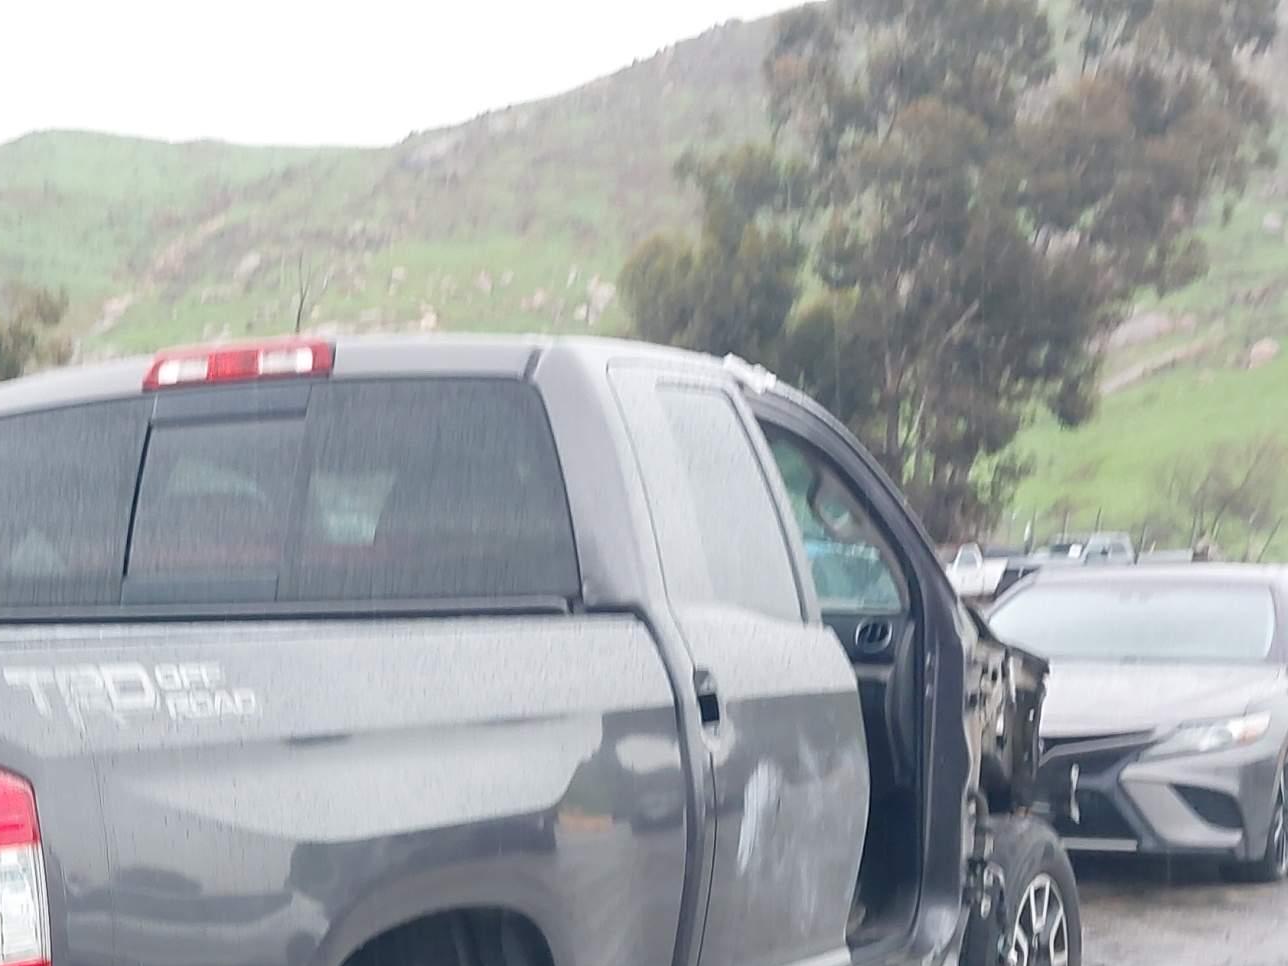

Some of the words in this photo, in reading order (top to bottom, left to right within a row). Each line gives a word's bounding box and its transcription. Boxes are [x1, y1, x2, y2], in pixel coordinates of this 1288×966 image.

[154, 662, 226, 690] OFF
[3, 661, 159, 728] TRD
[165, 688, 258, 720] ROAD
